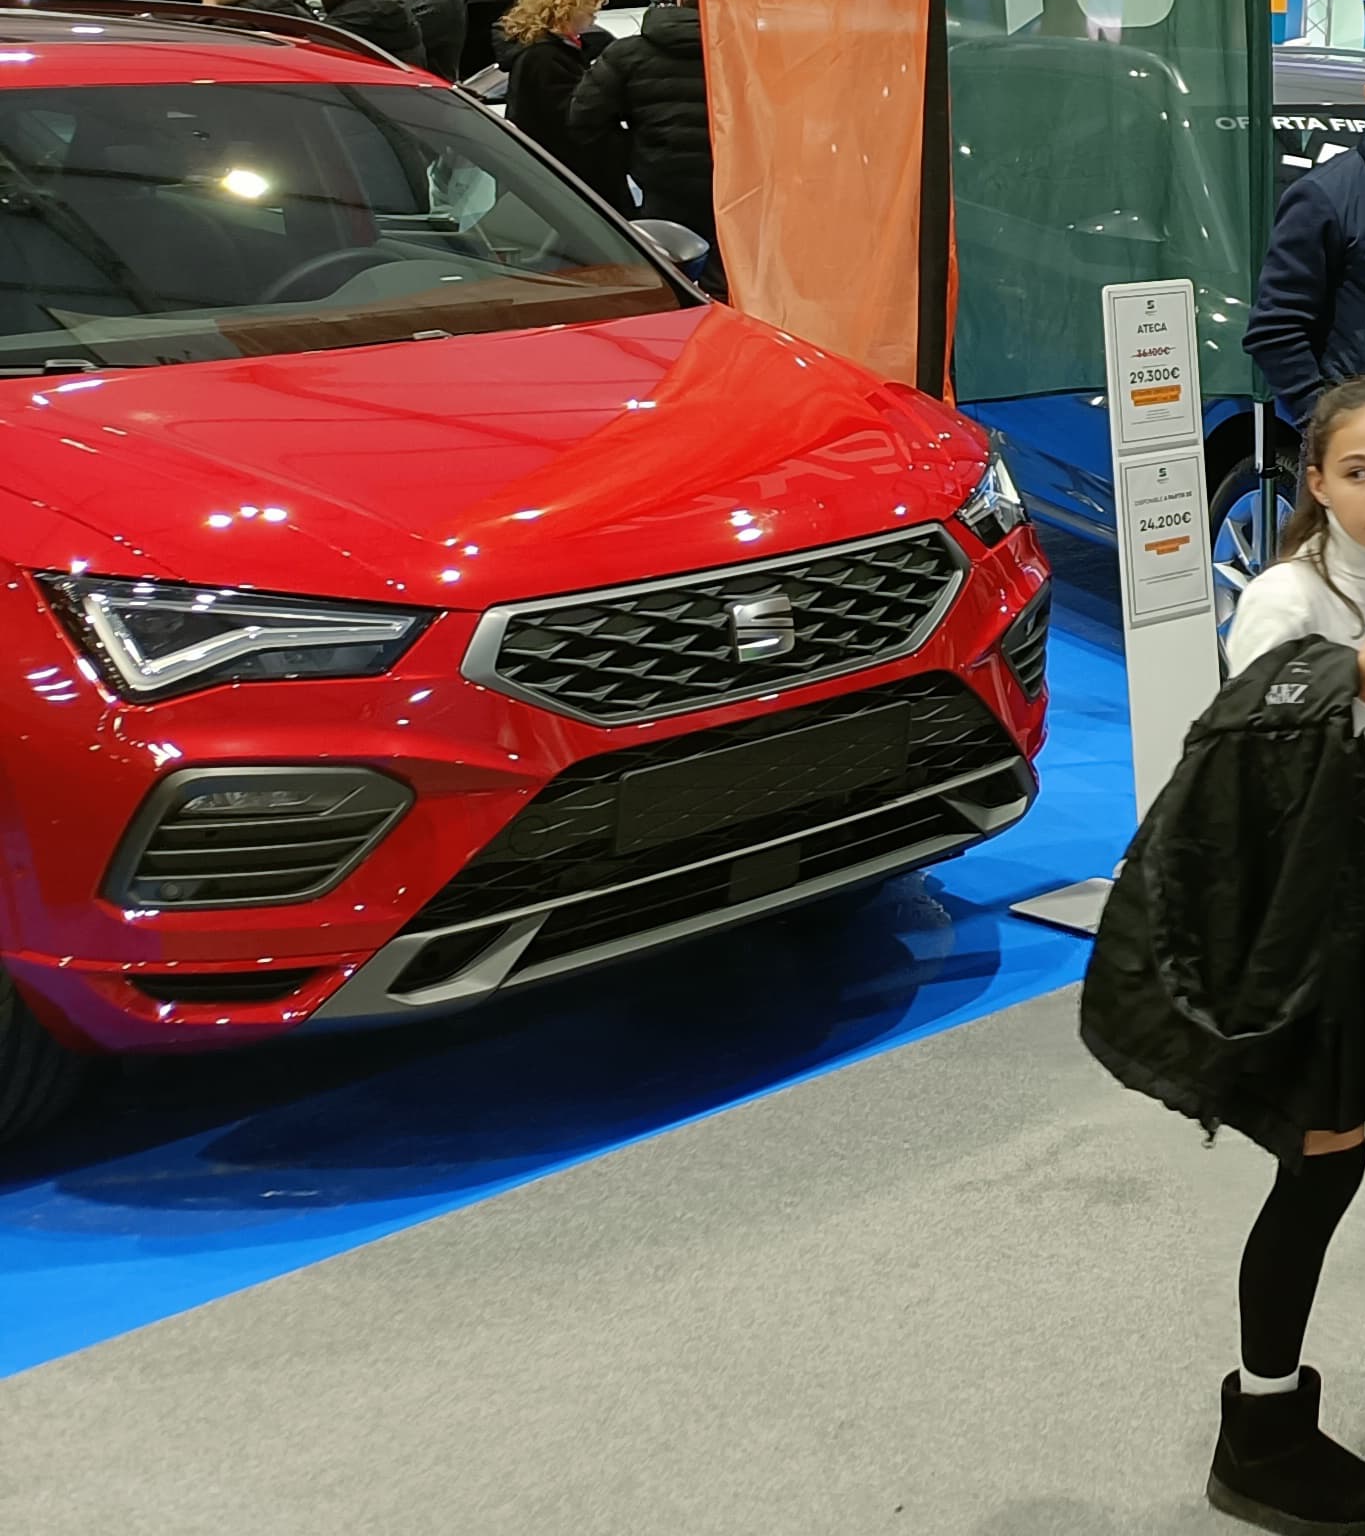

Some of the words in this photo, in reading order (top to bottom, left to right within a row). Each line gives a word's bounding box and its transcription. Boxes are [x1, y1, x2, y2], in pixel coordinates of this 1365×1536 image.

[1137, 322, 1168, 335] ATECA
[1129, 366, 1181, 385] 29.300€
[1139, 511, 1193, 532] 24.200€
